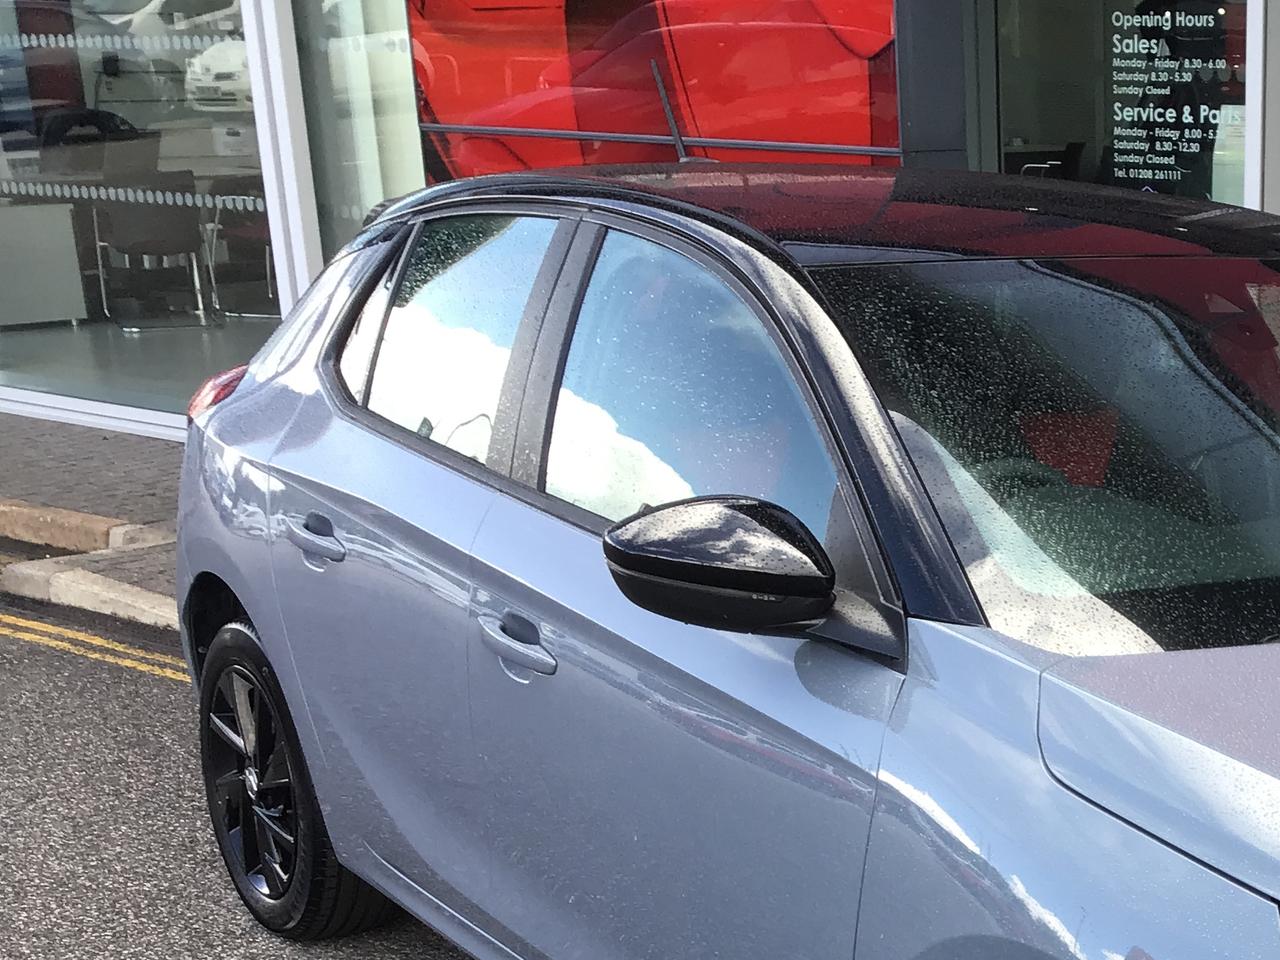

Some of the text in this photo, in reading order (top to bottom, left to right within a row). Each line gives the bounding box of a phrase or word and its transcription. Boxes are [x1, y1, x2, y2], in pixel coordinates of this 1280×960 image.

[1112, 11, 1215, 30] Opening Hours
[1112, 34, 1159, 54] Sales
[1112, 58, 1147, 70] Monday
[1154, 59, 1180, 70] Friday
[1184, 59, 1202, 69] 8.30
[1208, 59, 1226, 69] 6.00
[1112, 71, 1149, 82] Saturday
[1151, 72, 1169, 82] 8.30
[1175, 72, 1192, 82] 5.30
[1113, 85, 1170, 96] Sunday Closed
[1113, 102, 1241, 124] Service & Parts
[1114, 128, 1148, 139] Monday
[1155, 128, 1180, 140] Friday
[1184, 129, 1202, 139] 8.00
[1114, 140, 1150, 151] Saturday
[1155, 142, 1172, 151] 8.30
[1178, 142, 1200, 152] 12.30
[1114, 153, 1175, 165] Sunday Closed
[1129, 168, 1153, 179] 01208
[1154, 170, 1181, 180] 261111
